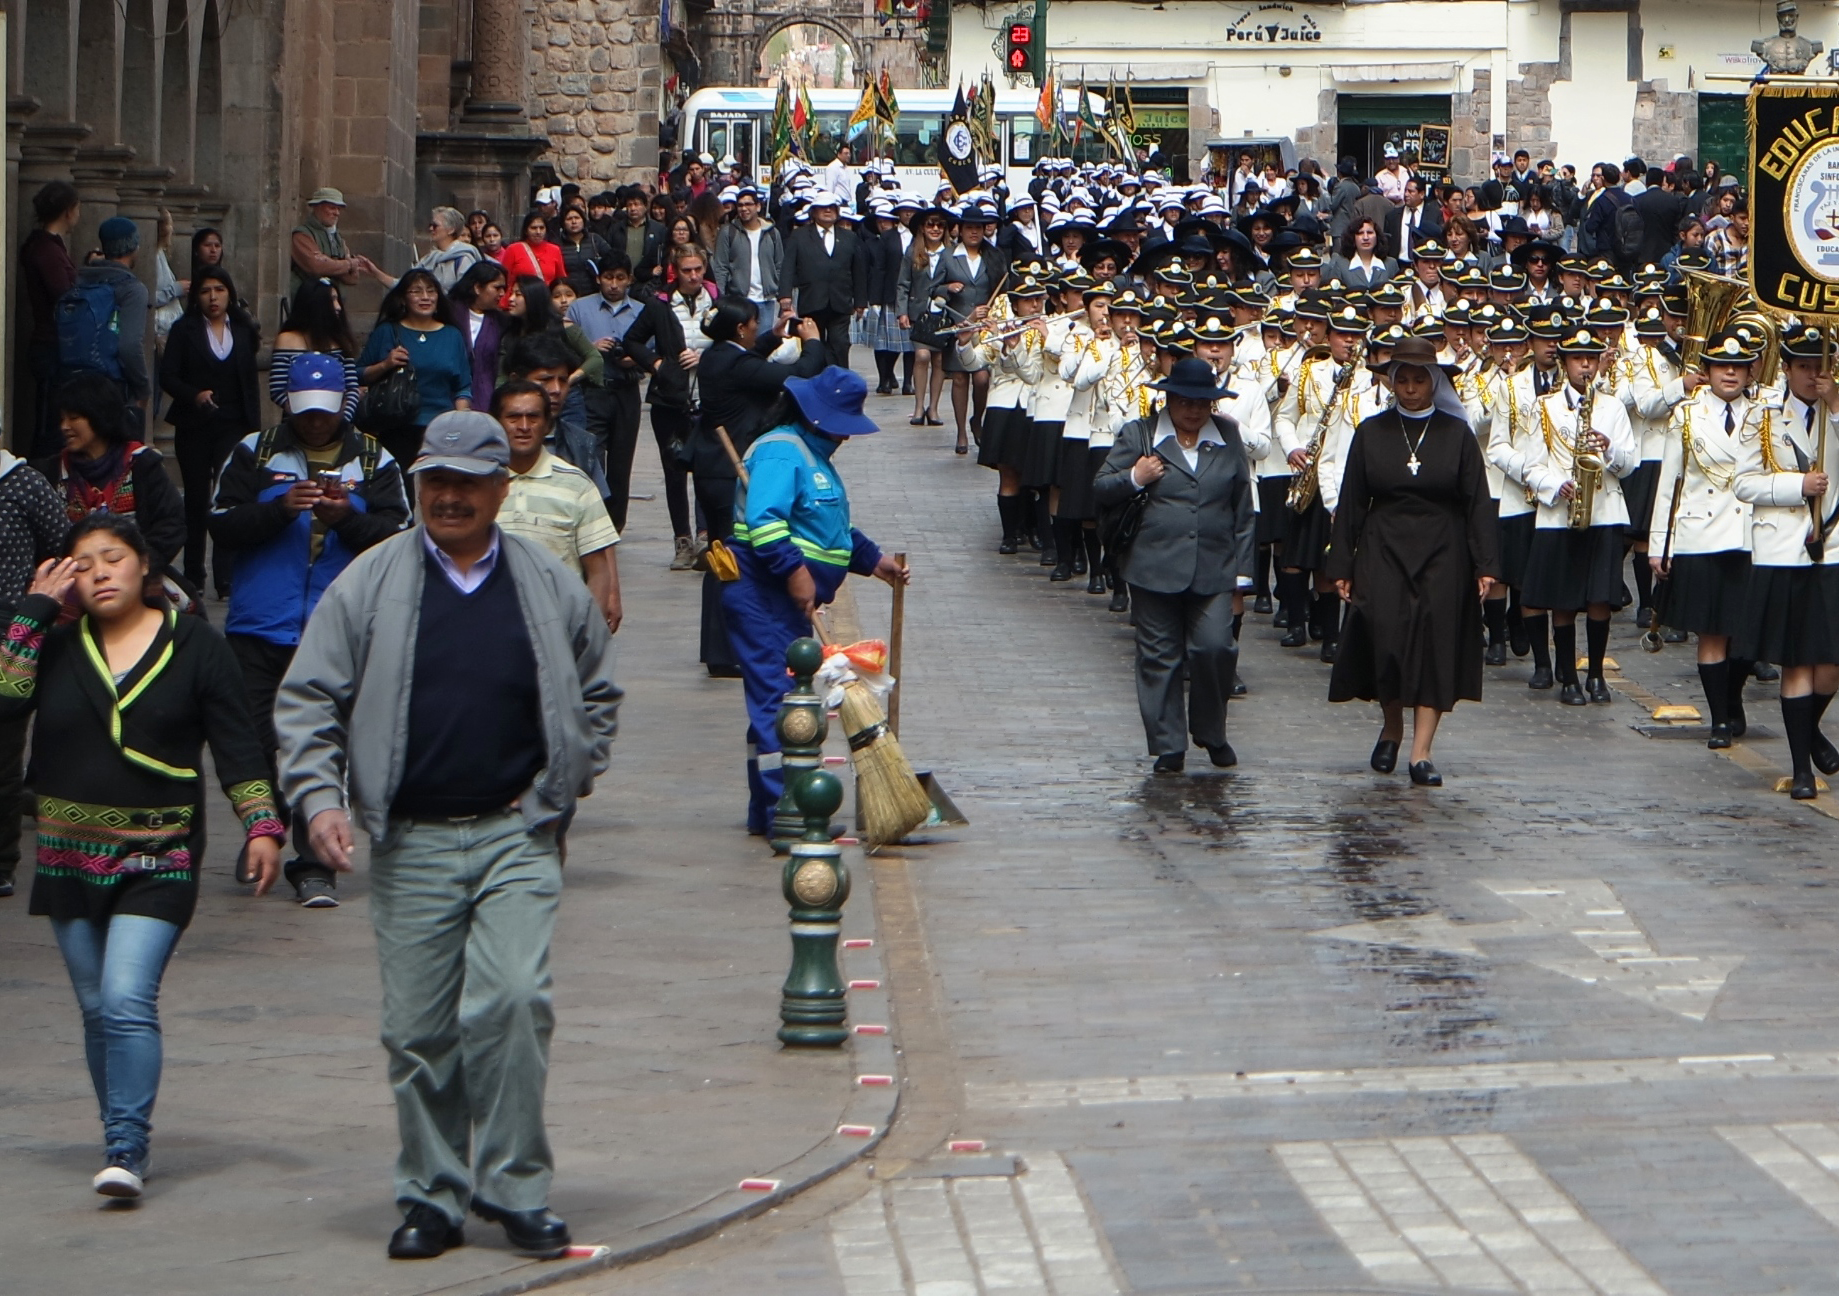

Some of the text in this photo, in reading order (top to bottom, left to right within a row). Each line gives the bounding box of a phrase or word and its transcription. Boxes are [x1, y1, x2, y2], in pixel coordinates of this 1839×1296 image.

[1011, 27, 1030, 42] 23
[1226, 24, 1322, 42] Perú Juice
[710, 111, 748, 119] BAJADA
[1143, 111, 1187, 123] Juice
[1793, 161, 1814, 213] FRANCISCANAS
[1813, 153, 1823, 163] DE
[1823, 148, 1832, 156] LA
[1819, 201, 1832, 212] PAZ
